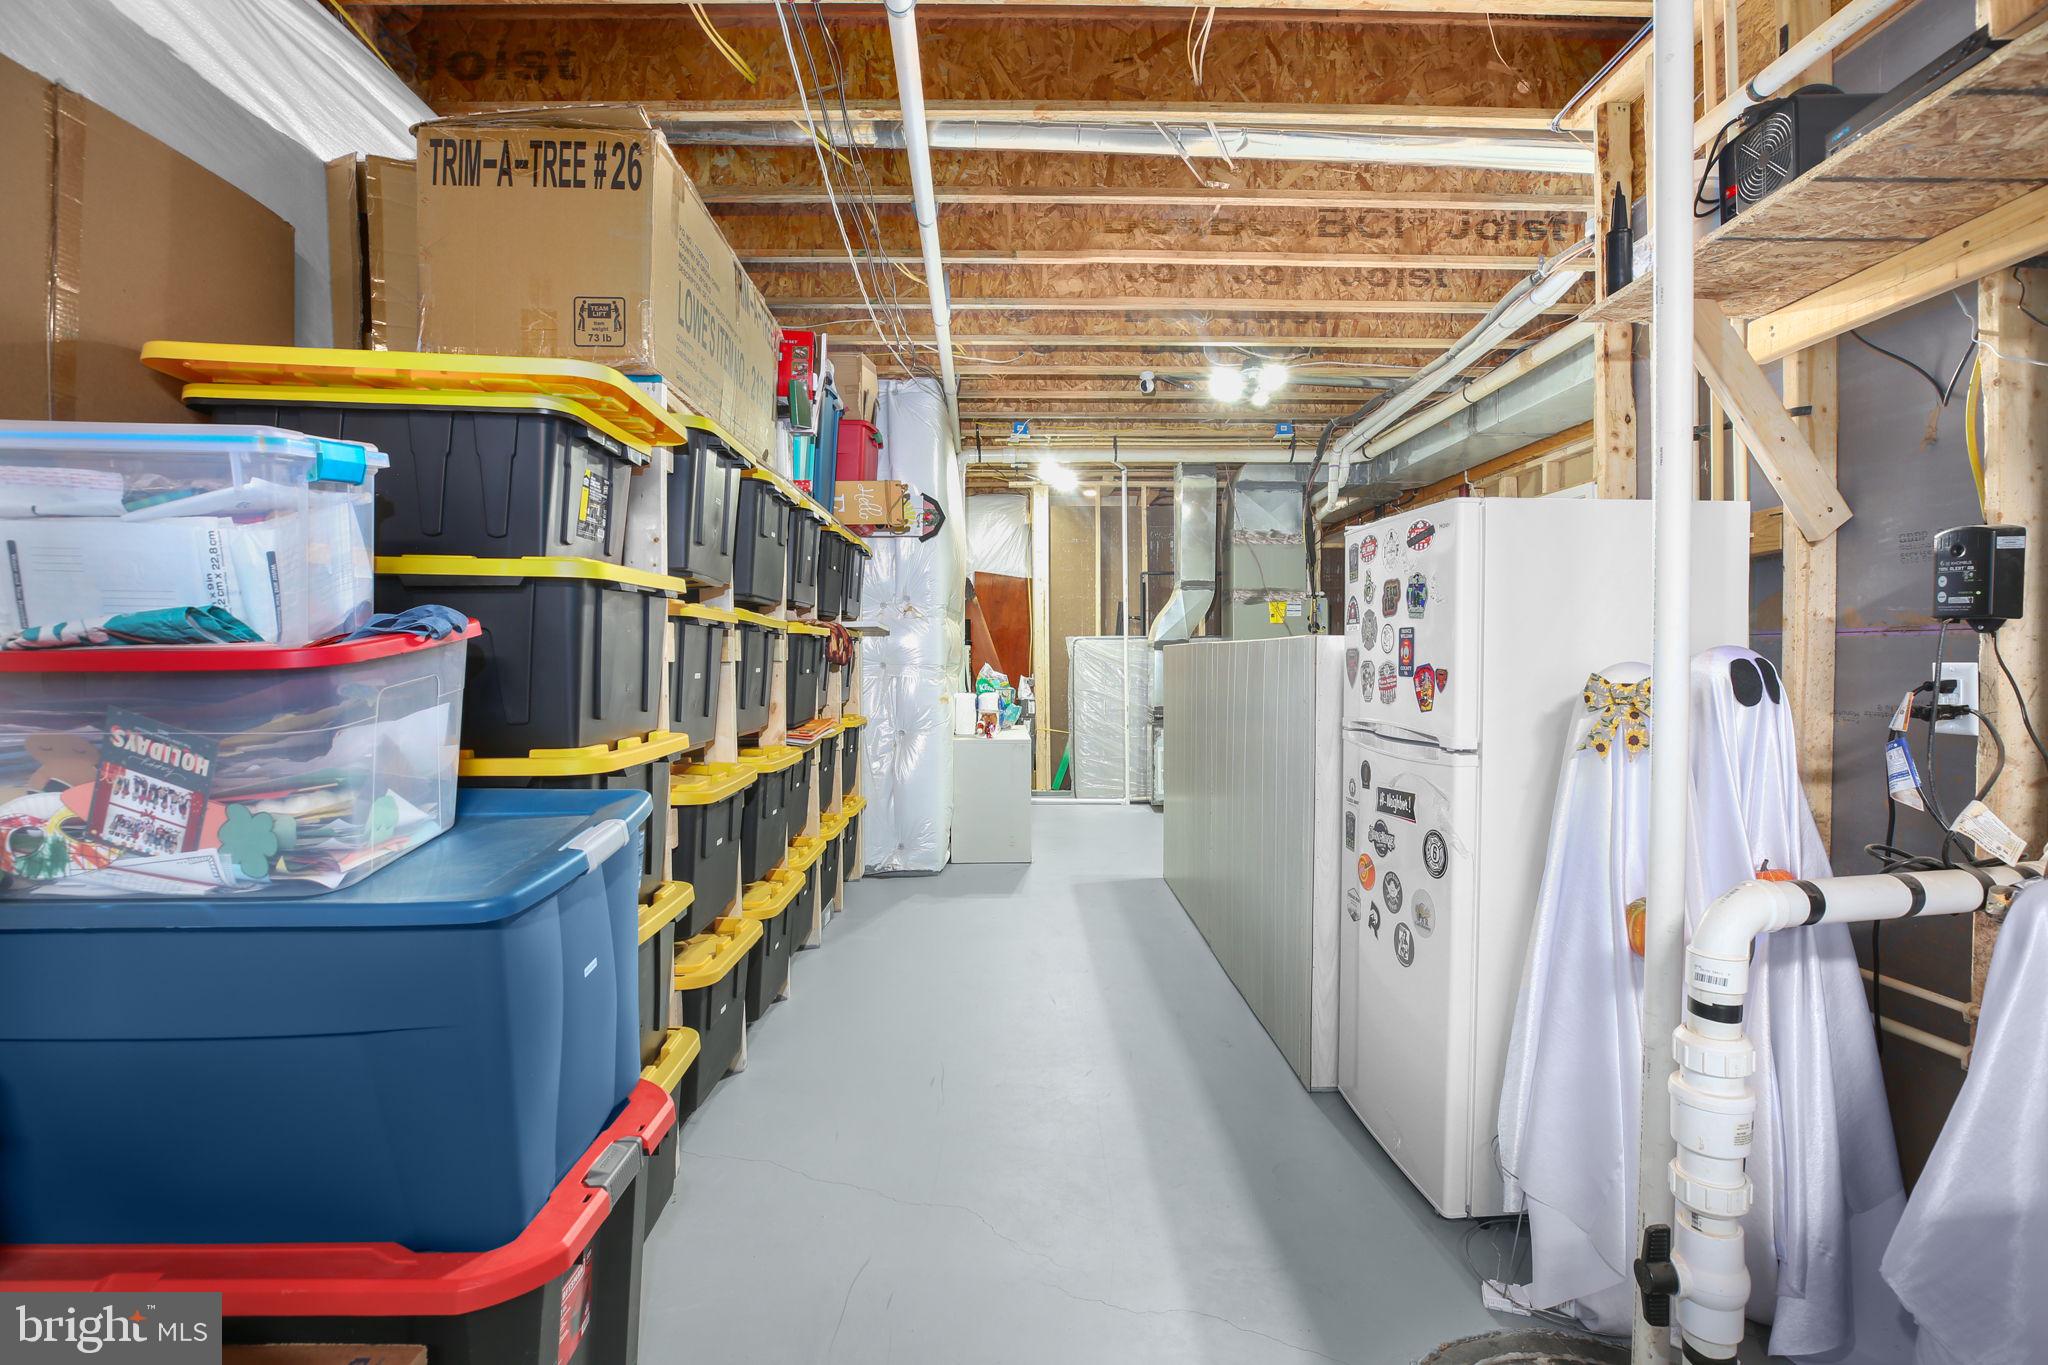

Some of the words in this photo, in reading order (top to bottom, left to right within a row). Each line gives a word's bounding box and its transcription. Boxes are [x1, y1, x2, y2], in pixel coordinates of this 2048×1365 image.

[430, 139, 586, 187] TRIM-A-TREE
[588, 333, 599, 342] 73
[602, 333, 612, 342] lb
[678, 280, 716, 358] LOWE'S
[208, 530, 216, 546] cm
[111, 726, 210, 777] HOLIDAYS
